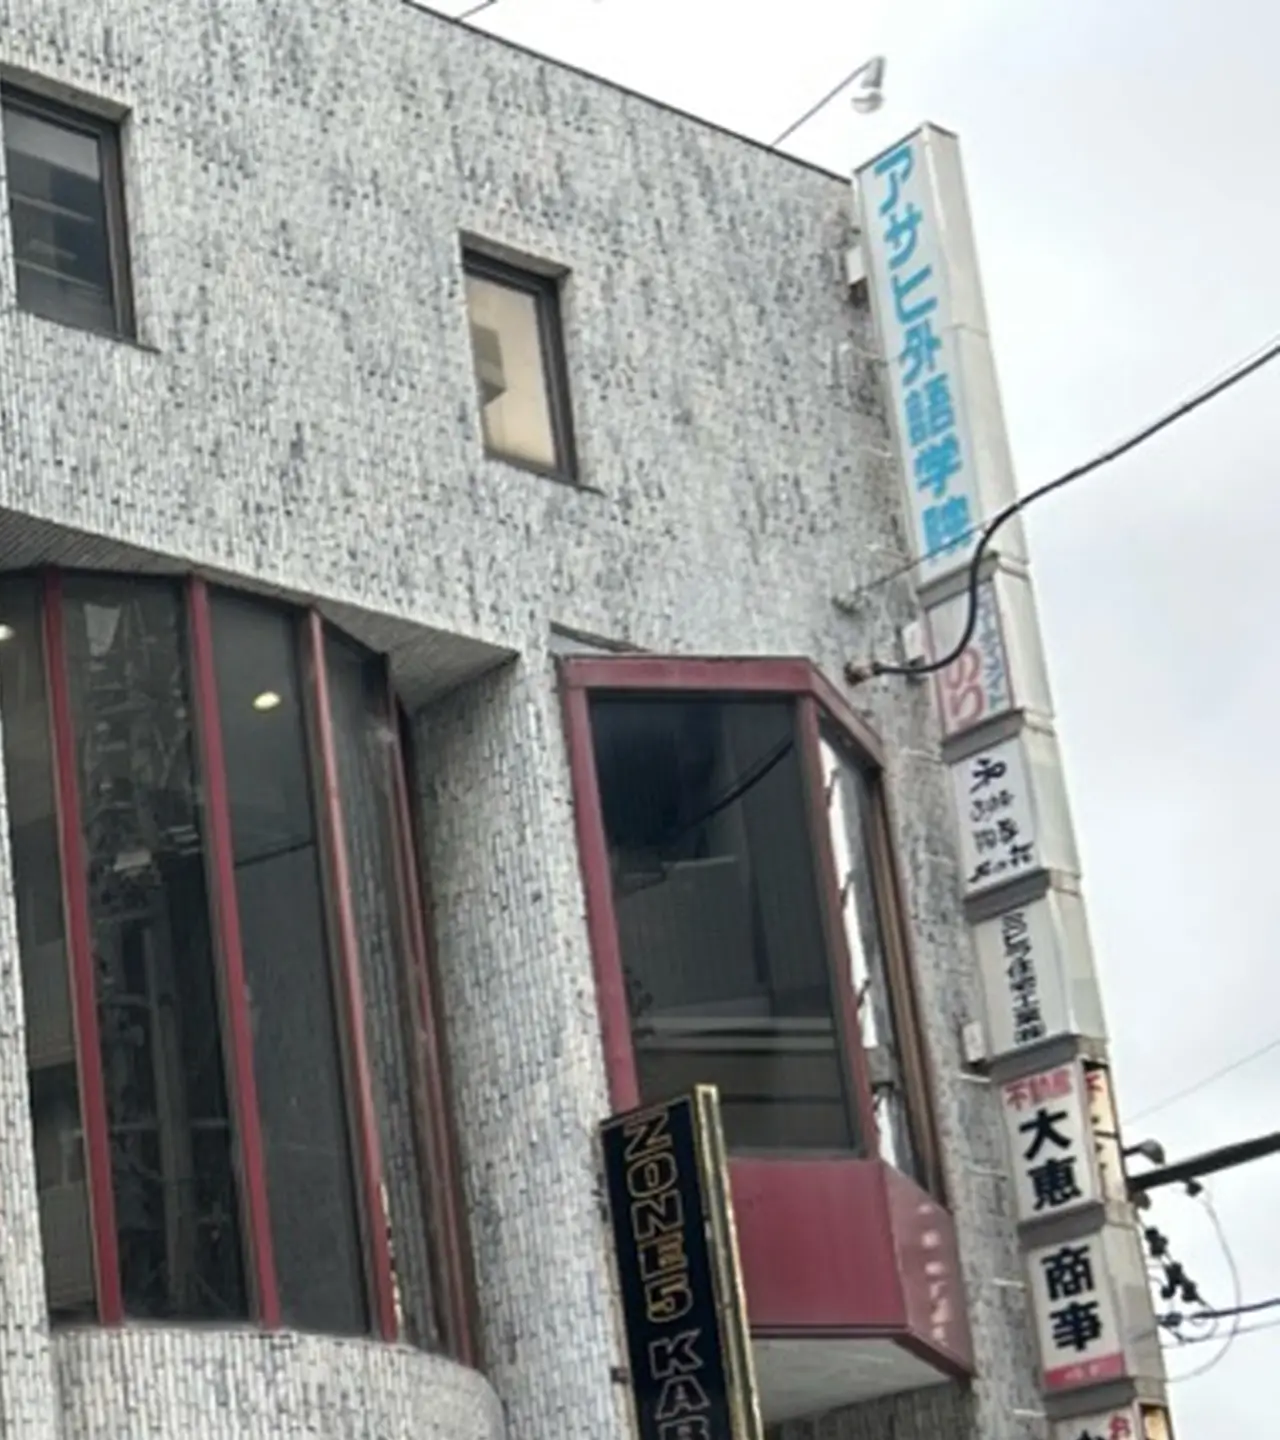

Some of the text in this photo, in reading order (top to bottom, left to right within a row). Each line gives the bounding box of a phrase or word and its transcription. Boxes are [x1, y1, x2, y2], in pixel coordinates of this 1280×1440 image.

[874, 144, 972, 564] アサヒ外語学院
